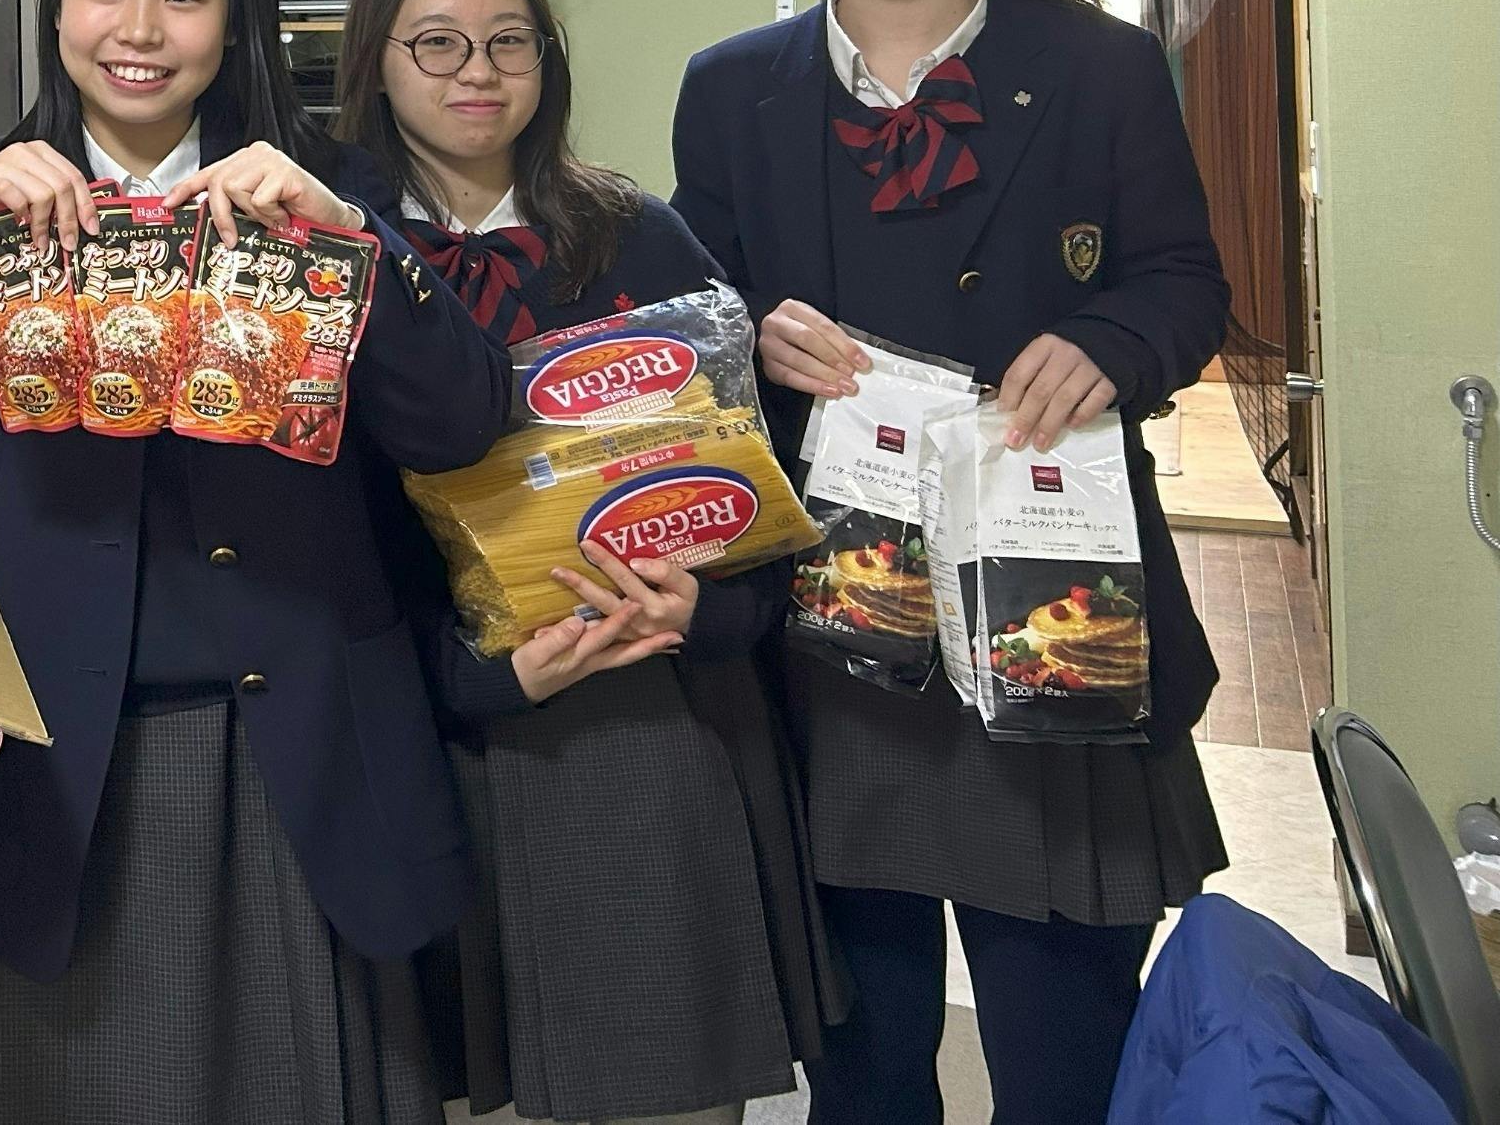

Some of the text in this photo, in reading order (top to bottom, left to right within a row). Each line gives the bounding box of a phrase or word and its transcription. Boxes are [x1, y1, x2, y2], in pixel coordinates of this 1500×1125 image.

[137, 206, 169, 218] Hachi
[97, 227, 195, 239] SPAGHETTI SAU
[273, 225, 304, 238] achi
[81, 239, 169, 270] たっぷり
[238, 235, 295, 256] AGHETTI
[207, 242, 296, 284] たっぷり
[83, 267, 189, 305] ミートソ
[202, 268, 357, 327] ミートソース
[301, 322, 352, 349] 285
[543, 347, 682, 408] REGGIA
[10, 383, 57, 405] 285g
[94, 384, 141, 406] 285g
[192, 379, 239, 407] 285g
[599, 385, 640, 405] Pasta
[621, 450, 675, 473] ゆで時間7分
[854, 458, 916, 482] 北海道産小麦の
[826, 465, 919, 496] バターミルクパンケーキ
[1019, 505, 1085, 517] 北海道産小麦の
[600, 495, 740, 557] REGGIA
[655, 534, 694, 555] Pasta
